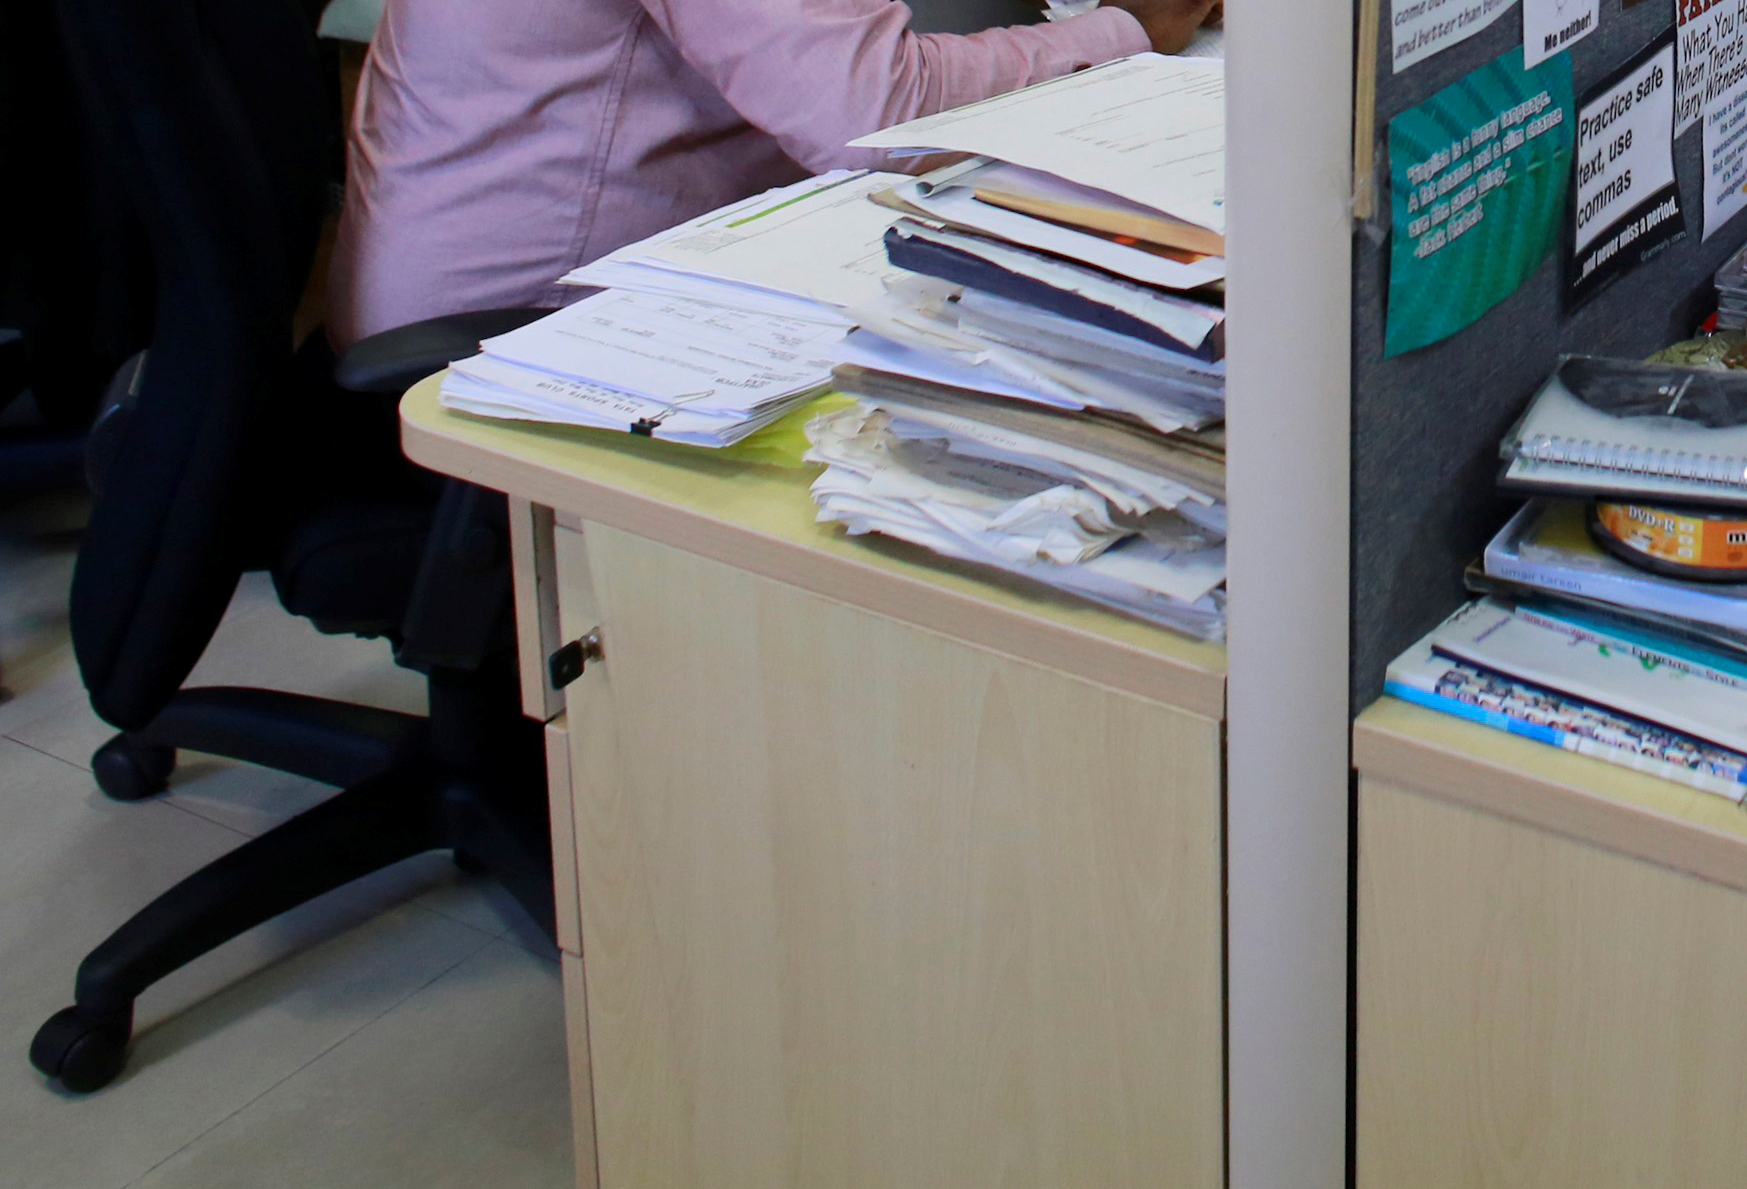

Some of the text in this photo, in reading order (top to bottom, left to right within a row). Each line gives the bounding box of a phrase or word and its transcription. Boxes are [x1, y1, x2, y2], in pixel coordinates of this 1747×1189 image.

[1394, 0, 1426, 27] come
[1395, 29, 1417, 60] and
[1418, 18, 1457, 48] better
[1458, 5, 1482, 28] than
[1544, 10, 1592, 53] Me neither!
[1683, 22, 1713, 65] What
[1714, 10, 1734, 44] You
[1676, 61, 1705, 97] When
[1708, 33, 1743, 77] There's
[1580, 65, 1664, 149] Practice safe
[1675, 91, 1703, 129] Many
[1712, 106, 1727, 124] have
[1728, 106, 1746, 130] called
[1408, 107, 1563, 215] A fat chance and a slim chance
[1451, 140, 1462, 162] is
[1462, 136, 1471, 154] a
[1470, 117, 1499, 148] funny
[1578, 128, 1633, 189] text, use
[1712, 161, 1724, 177] But
[1732, 157, 1744, 176] NOT
[1408, 214, 1431, 239] are
[1430, 202, 1450, 228] the
[1450, 184, 1477, 215] same
[1577, 168, 1632, 230] commas
[1596, 235, 1619, 266] never
[1619, 221, 1640, 250] miss
[1639, 217, 1646, 233] a
[1646, 195, 1680, 233] period.
[1640, 230, 1688, 262] Grammarly.com
[1631, 646, 1692, 674] ELEMENTS
[1705, 670, 1740, 689] STYLE
